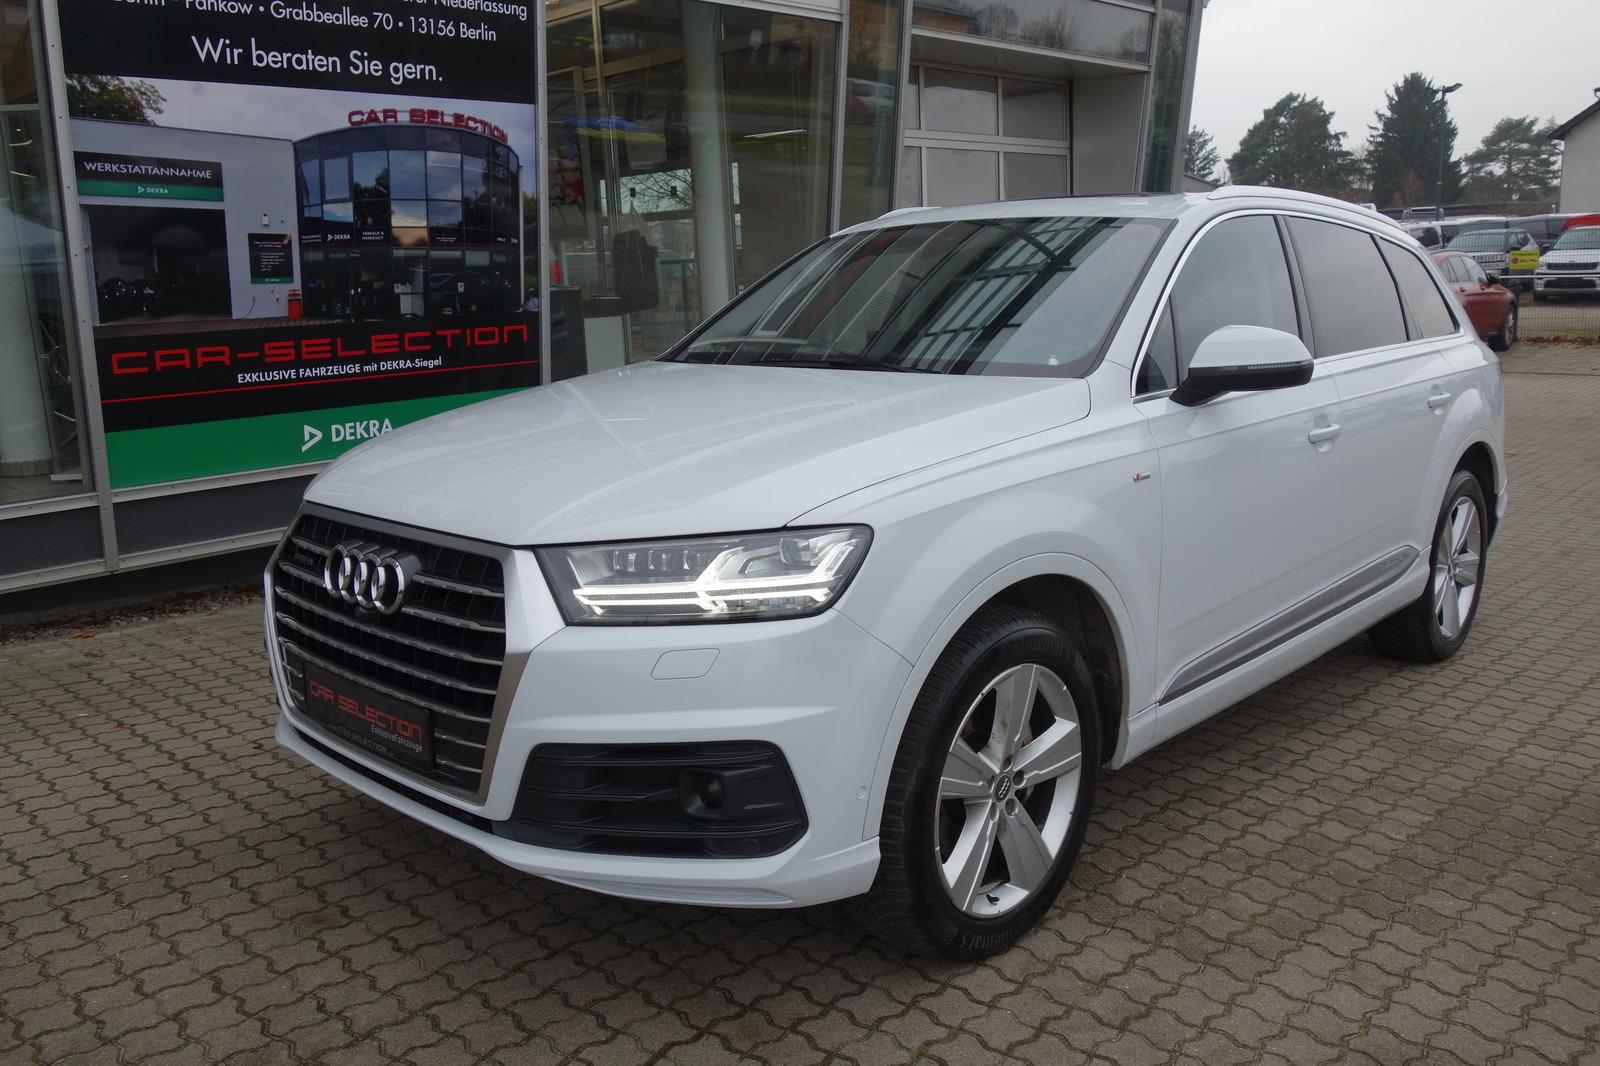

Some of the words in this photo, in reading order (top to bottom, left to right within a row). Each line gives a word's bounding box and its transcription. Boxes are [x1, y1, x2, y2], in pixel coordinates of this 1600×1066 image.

[270, 0, 368, 28] Grabbeallee
[373, 11, 393, 30] 70
[409, 16, 456, 37] 13156
[460, 22, 497, 42] Berlin
[191, 35, 243, 65] Wir
[251, 37, 341, 73] beraten
[349, 49, 383, 76] Sie
[389, 60, 443, 85] gern.
[347, 108, 398, 126] CAR
[409, 108, 508, 143] SELECTION
[84, 161, 212, 179] WERKSTATTANNAHME
[111, 323, 529, 375] CAR-SELECTION
[237, 368, 297, 384] EXKLUSIVE
[299, 362, 361, 379] FAHRZEUGE
[363, 360, 378, 374] mit
[380, 355, 443, 373] DEKRA-Siegel
[332, 418, 393, 442] DEKRA
[309, 680, 335, 704] CAR
[337, 694, 422, 743] SELECTION
